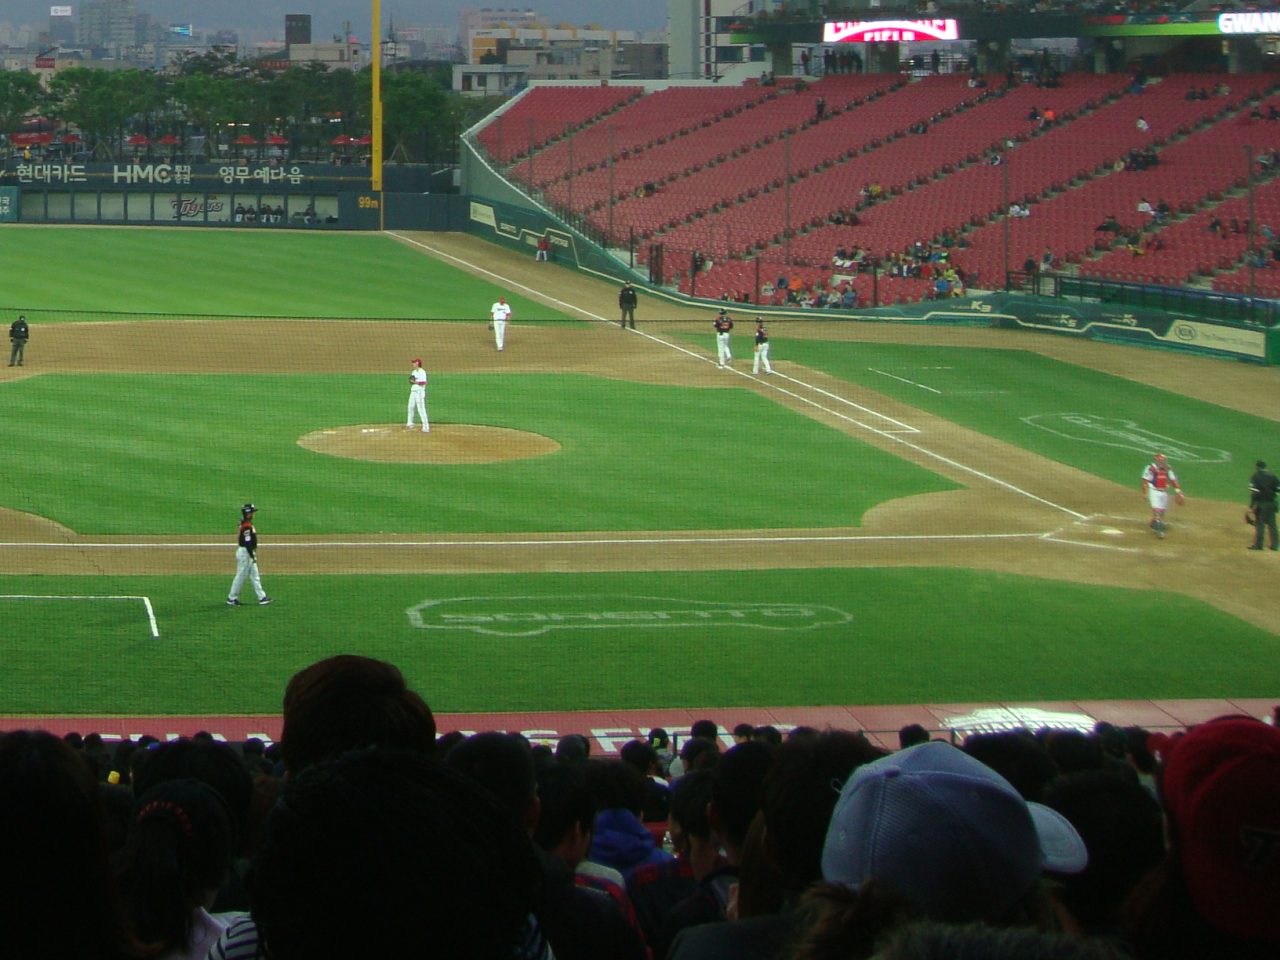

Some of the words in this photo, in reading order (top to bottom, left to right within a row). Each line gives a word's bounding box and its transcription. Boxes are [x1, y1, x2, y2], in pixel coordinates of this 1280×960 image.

[1218, 13, 1280, 33] GWAN
[16, 164, 87, 183] 현대카드
[113, 164, 172, 184] HMC
[358, 196, 379, 209] 99m
